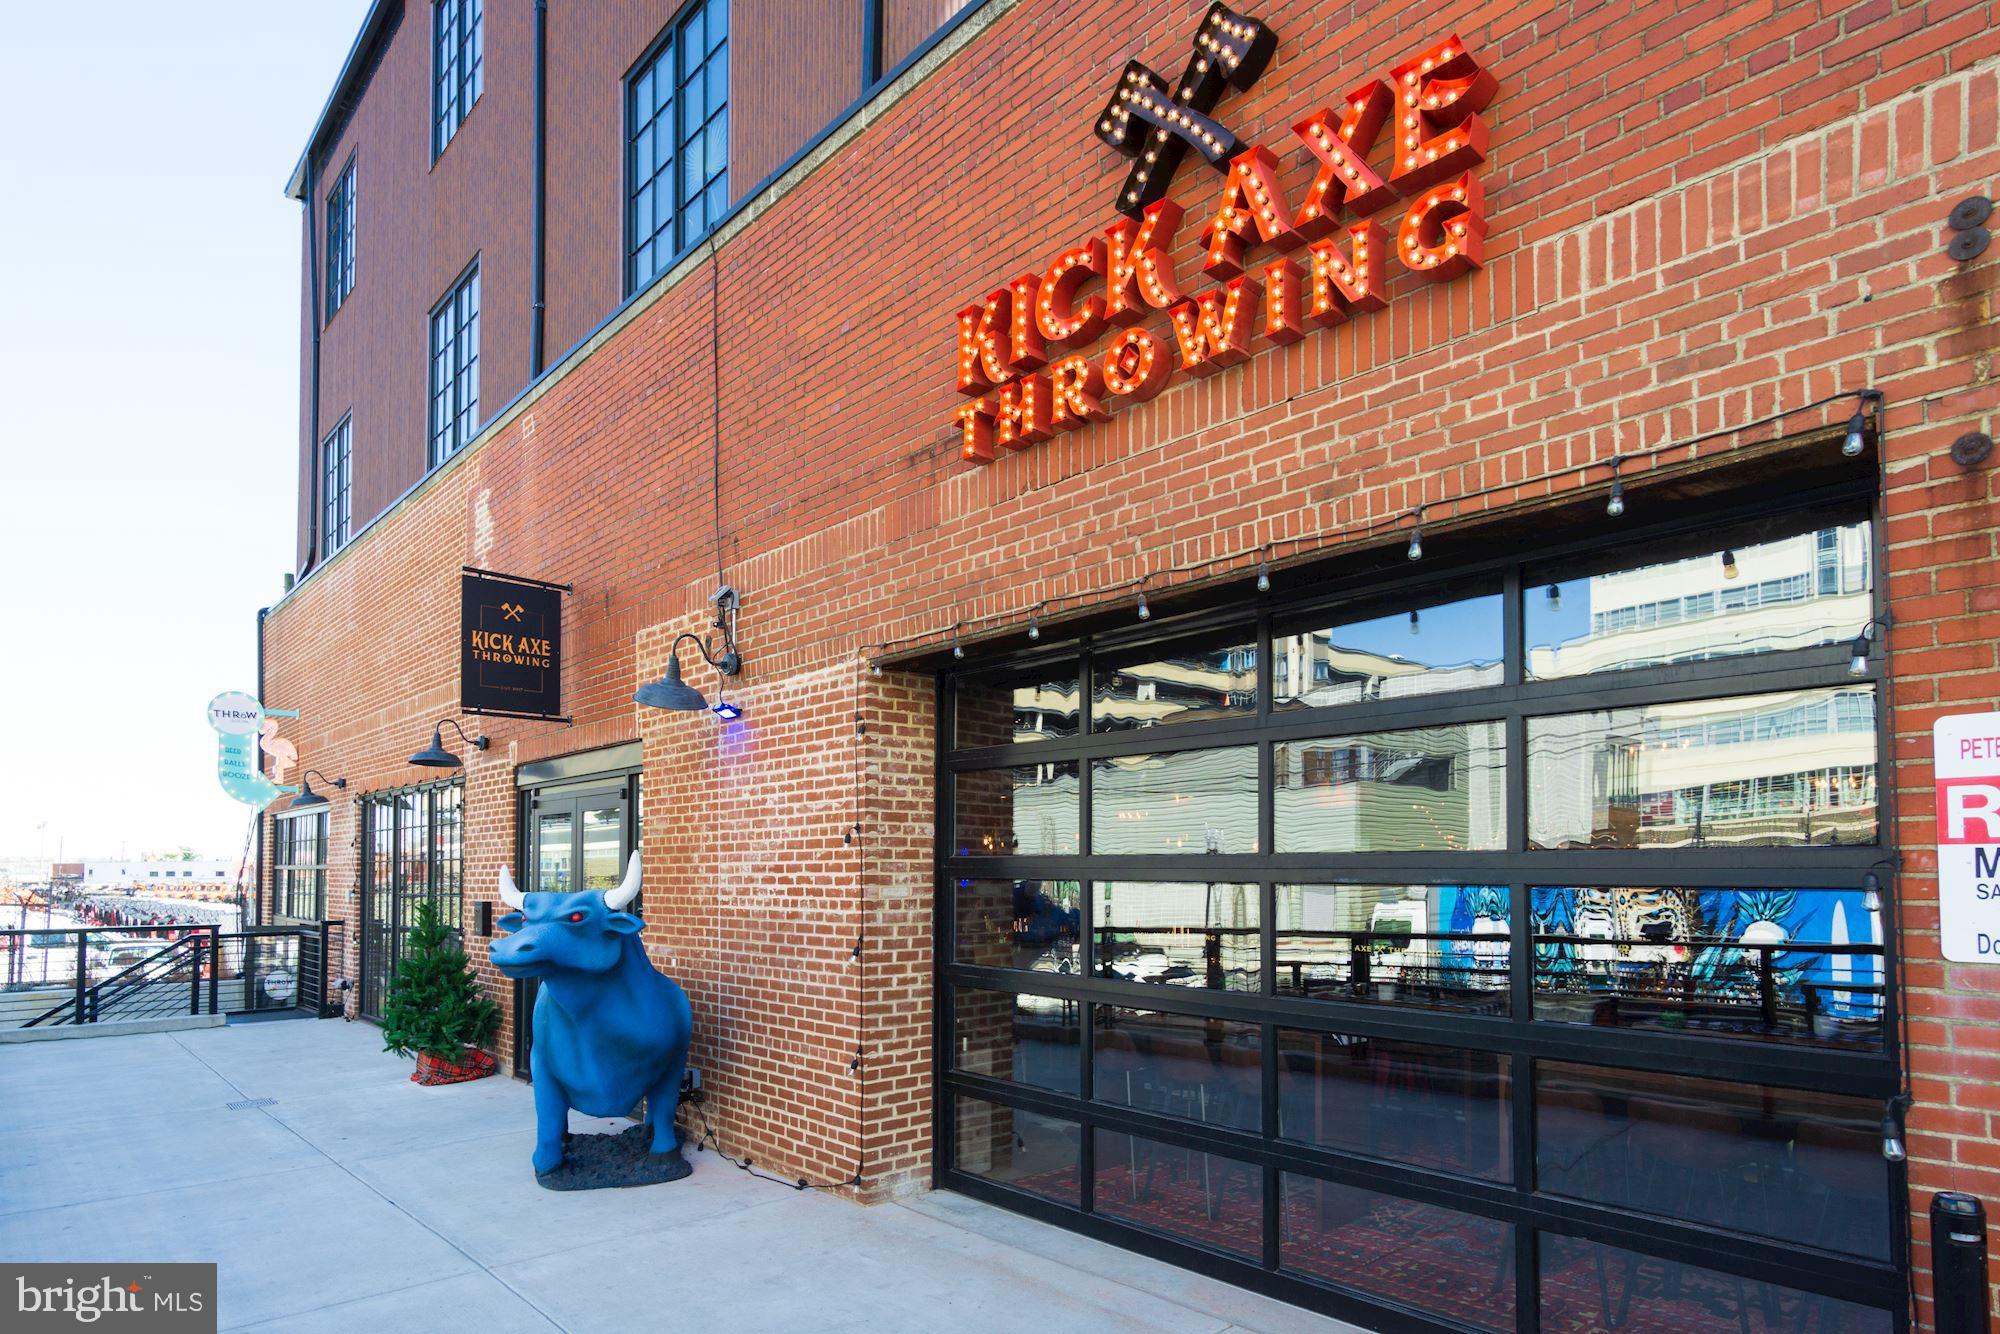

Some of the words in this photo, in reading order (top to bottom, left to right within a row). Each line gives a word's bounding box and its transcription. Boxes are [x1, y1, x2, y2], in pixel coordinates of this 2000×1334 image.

[956, 197, 1186, 396] KICK
[1201, 33, 1499, 281] AXE
[954, 170, 1489, 465] THROWING
[471, 630, 515, 655] KICK
[518, 636, 551, 657] AXE
[472, 649, 551, 668] THROWING
